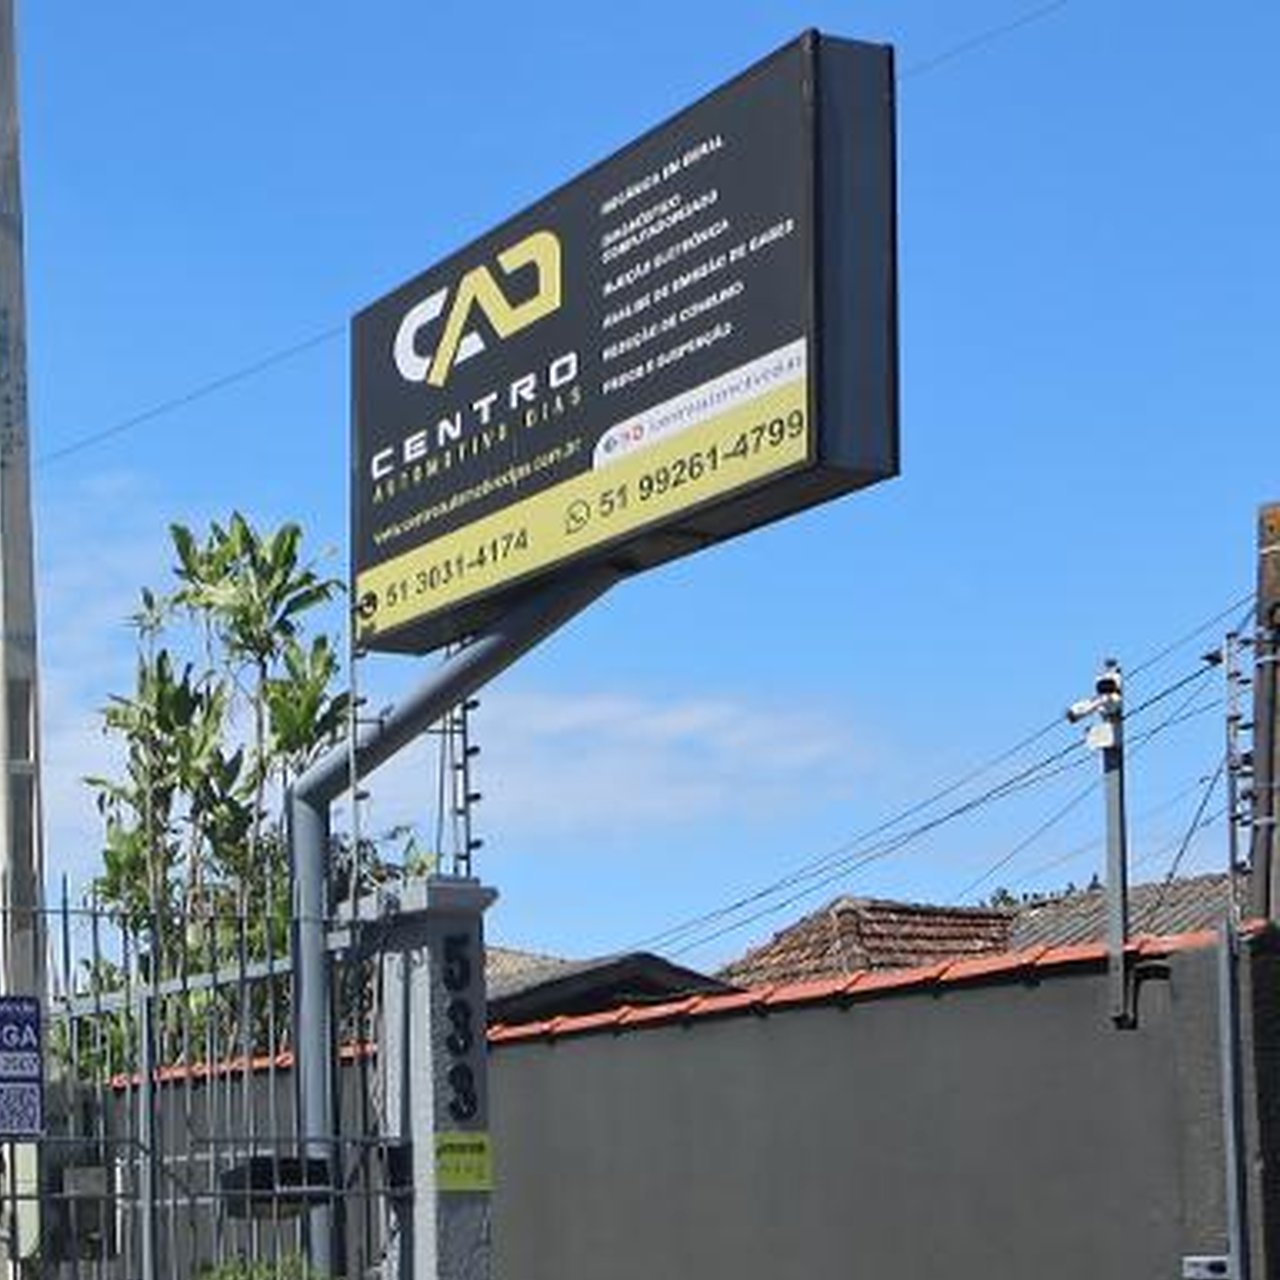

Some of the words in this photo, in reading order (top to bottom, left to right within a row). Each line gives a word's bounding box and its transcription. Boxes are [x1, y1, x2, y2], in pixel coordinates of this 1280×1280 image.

[371, 351, 578, 480] CENTRO
[525, 385, 582, 429] DIAS
[598, 486, 629, 519] 51
[639, 409, 805, 502] 99261-4799
[386, 582, 410, 609] 51
[414, 529, 529, 597] 3031-4174
